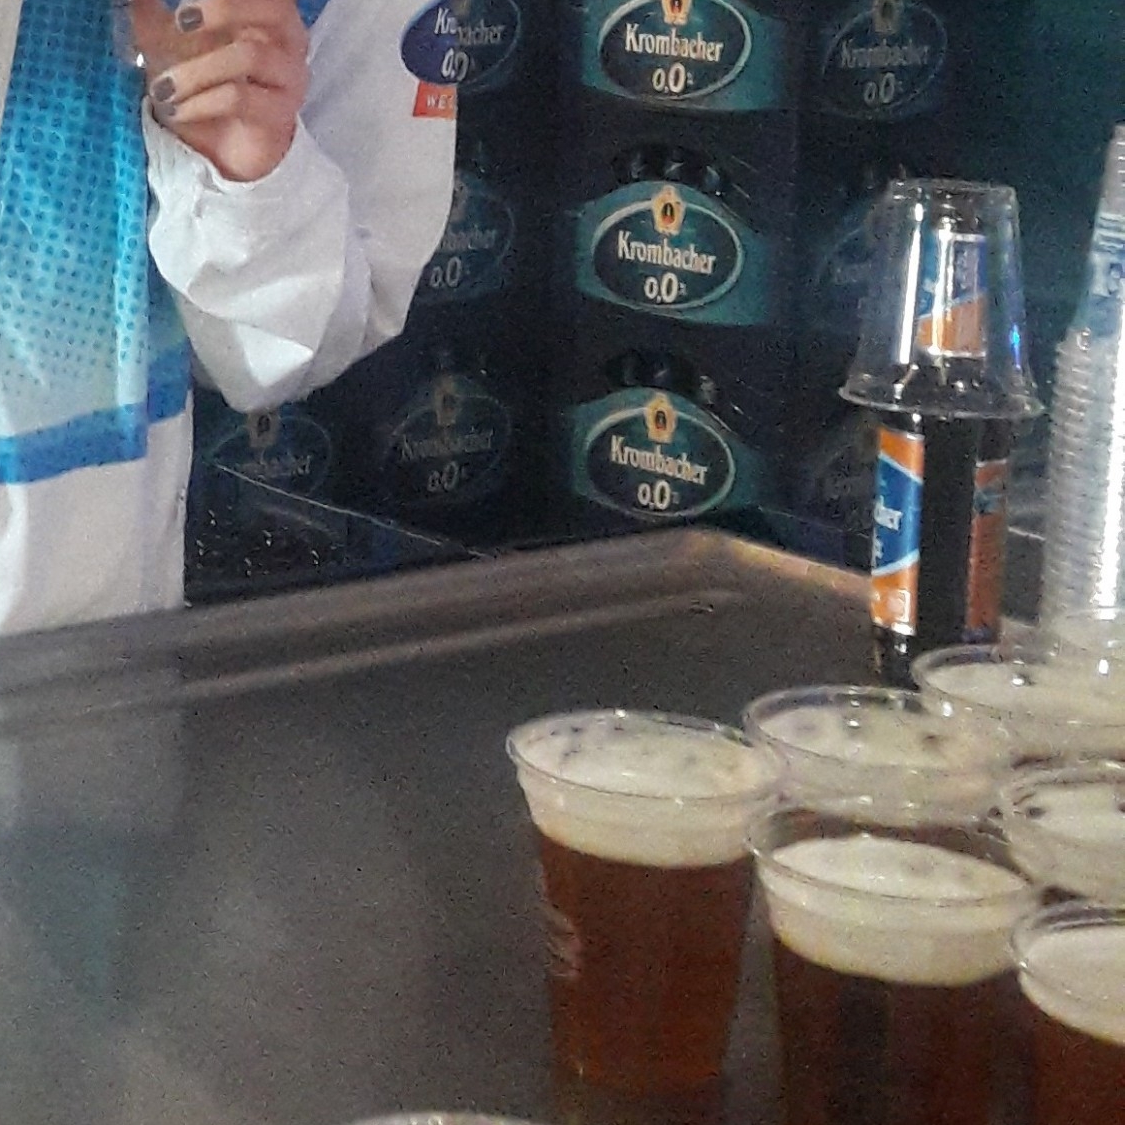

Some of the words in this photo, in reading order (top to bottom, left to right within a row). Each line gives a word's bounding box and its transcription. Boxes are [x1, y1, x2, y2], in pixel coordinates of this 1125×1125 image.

[625, 22, 724, 62] Krombacher
[618, 230, 716, 275] Krombacher
[611, 434, 708, 485] Krombacher
